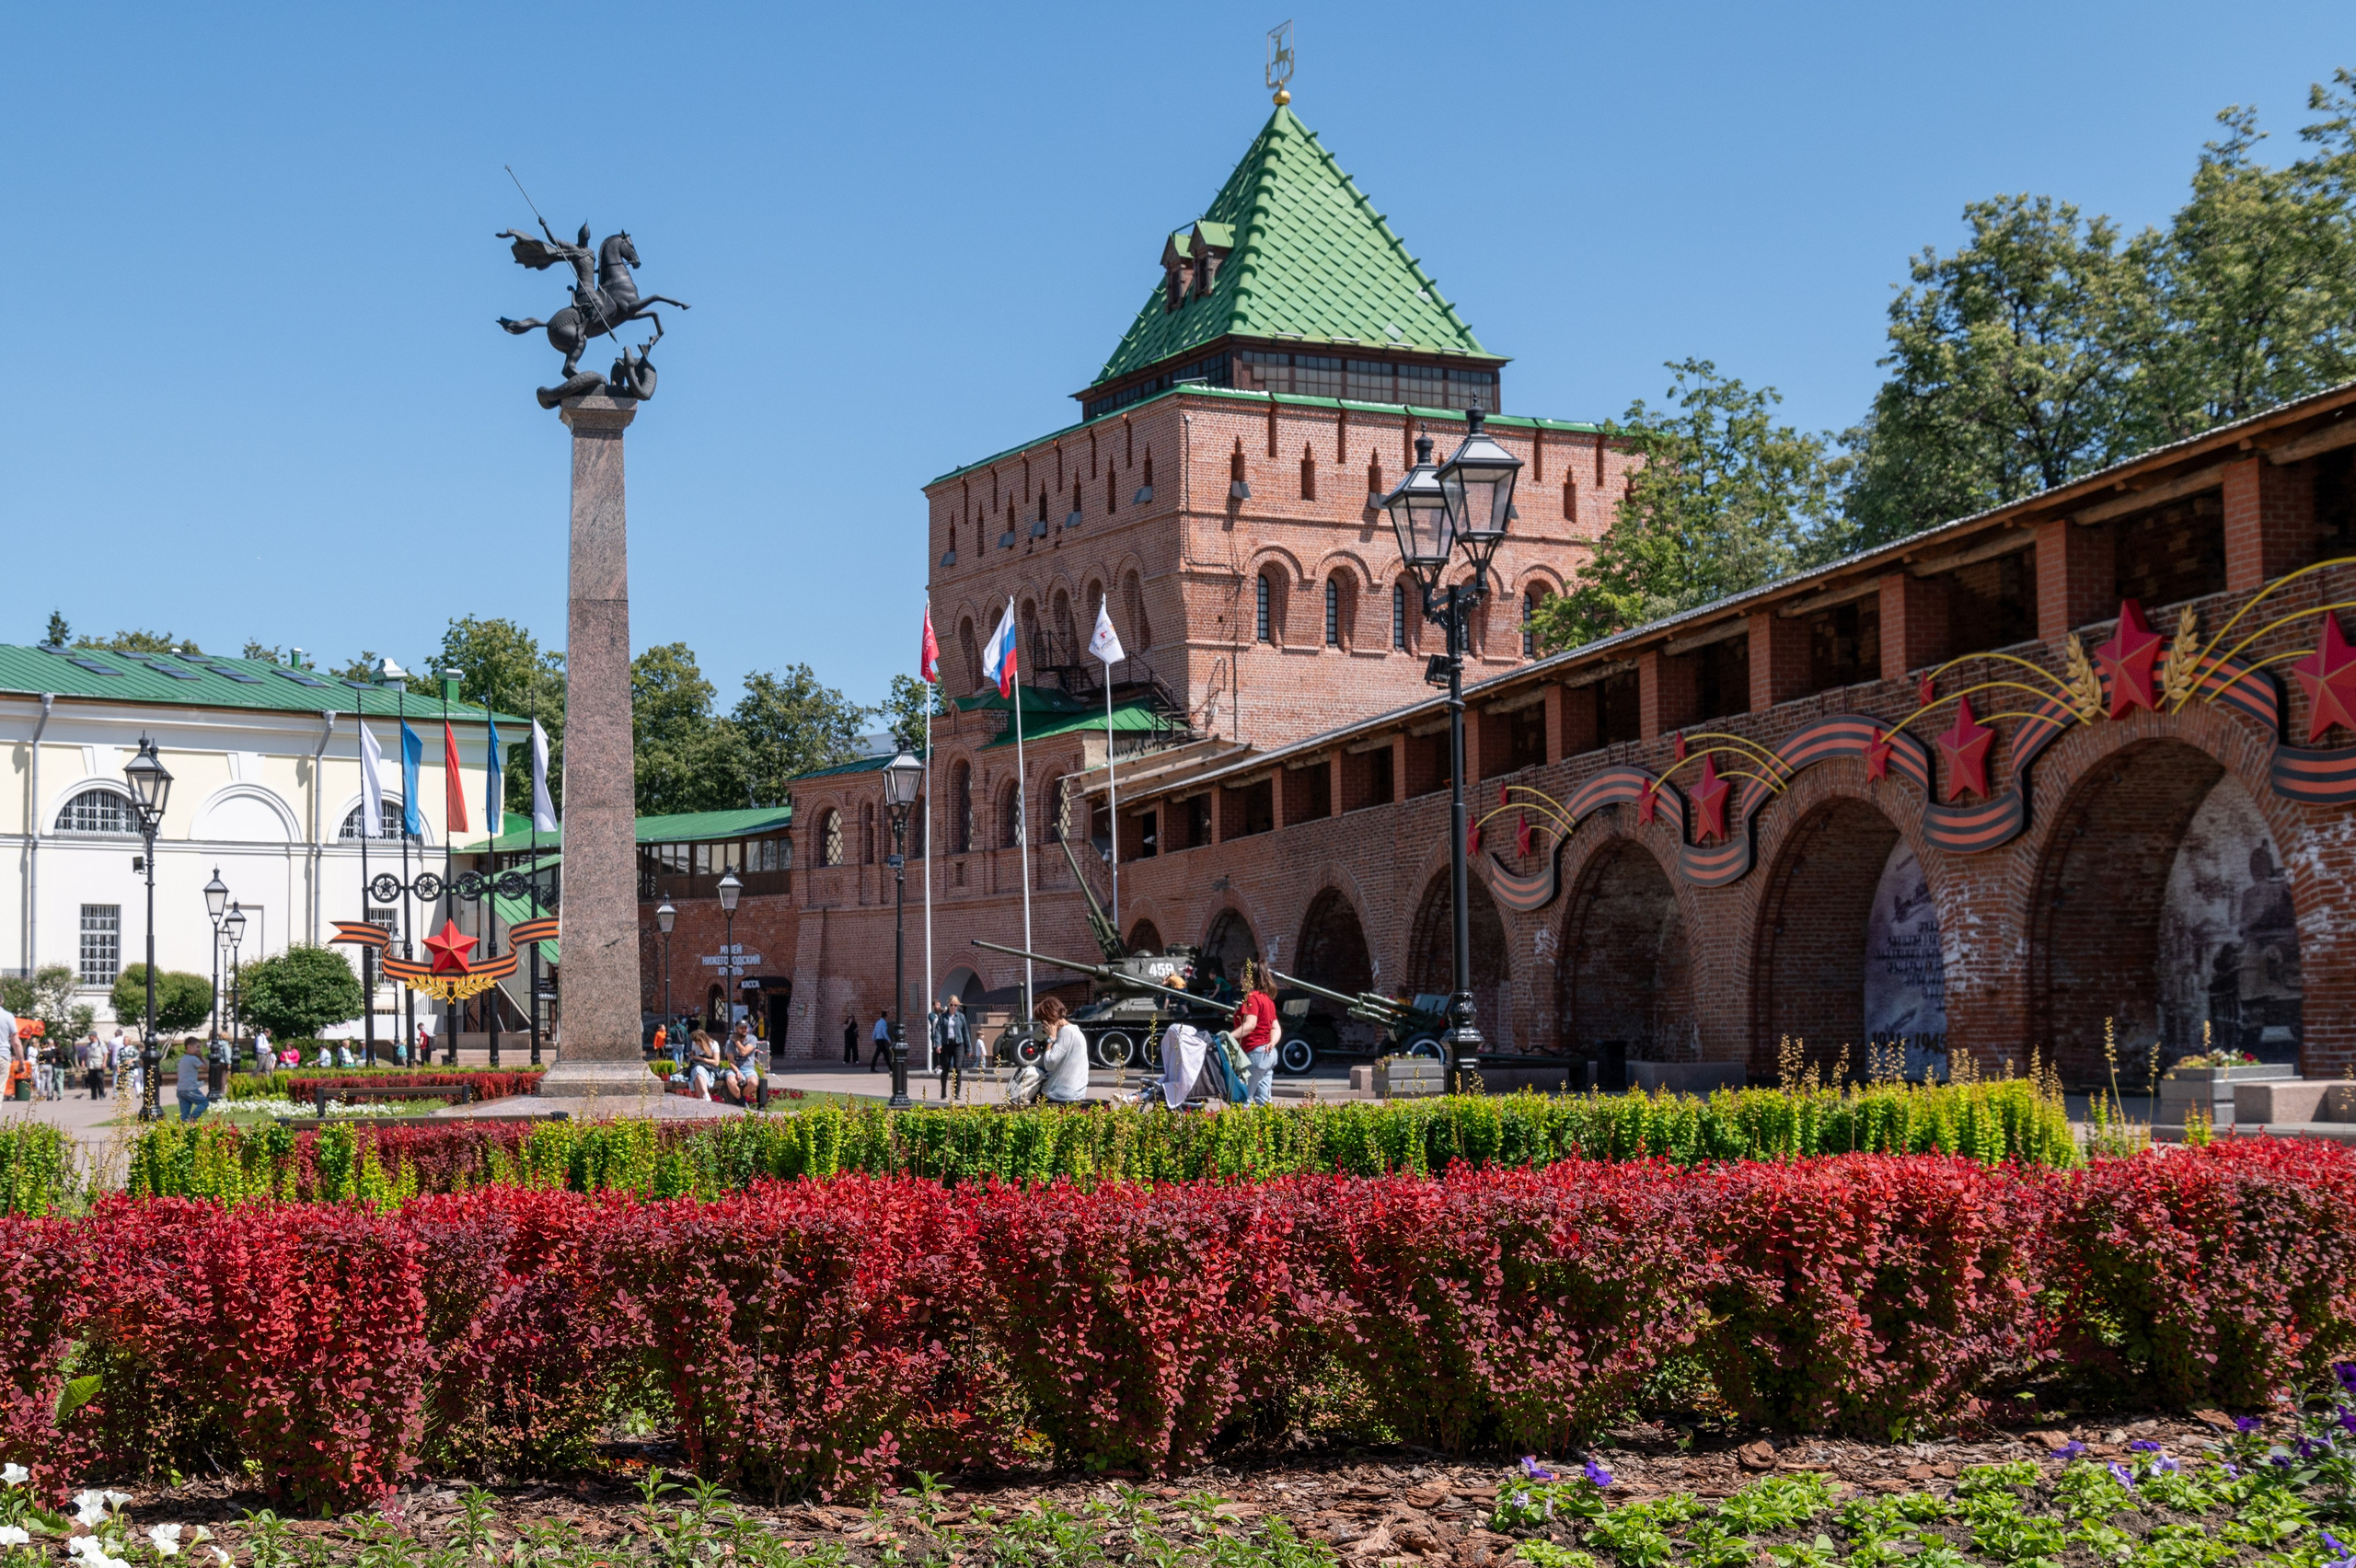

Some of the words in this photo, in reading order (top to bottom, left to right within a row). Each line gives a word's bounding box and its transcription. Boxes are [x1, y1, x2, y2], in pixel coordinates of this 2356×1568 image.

[702, 954, 761, 966] НИЖЕГООДСКИЙ
[1149, 963, 1174, 976] 459
[741, 980, 760, 988] КАССА
